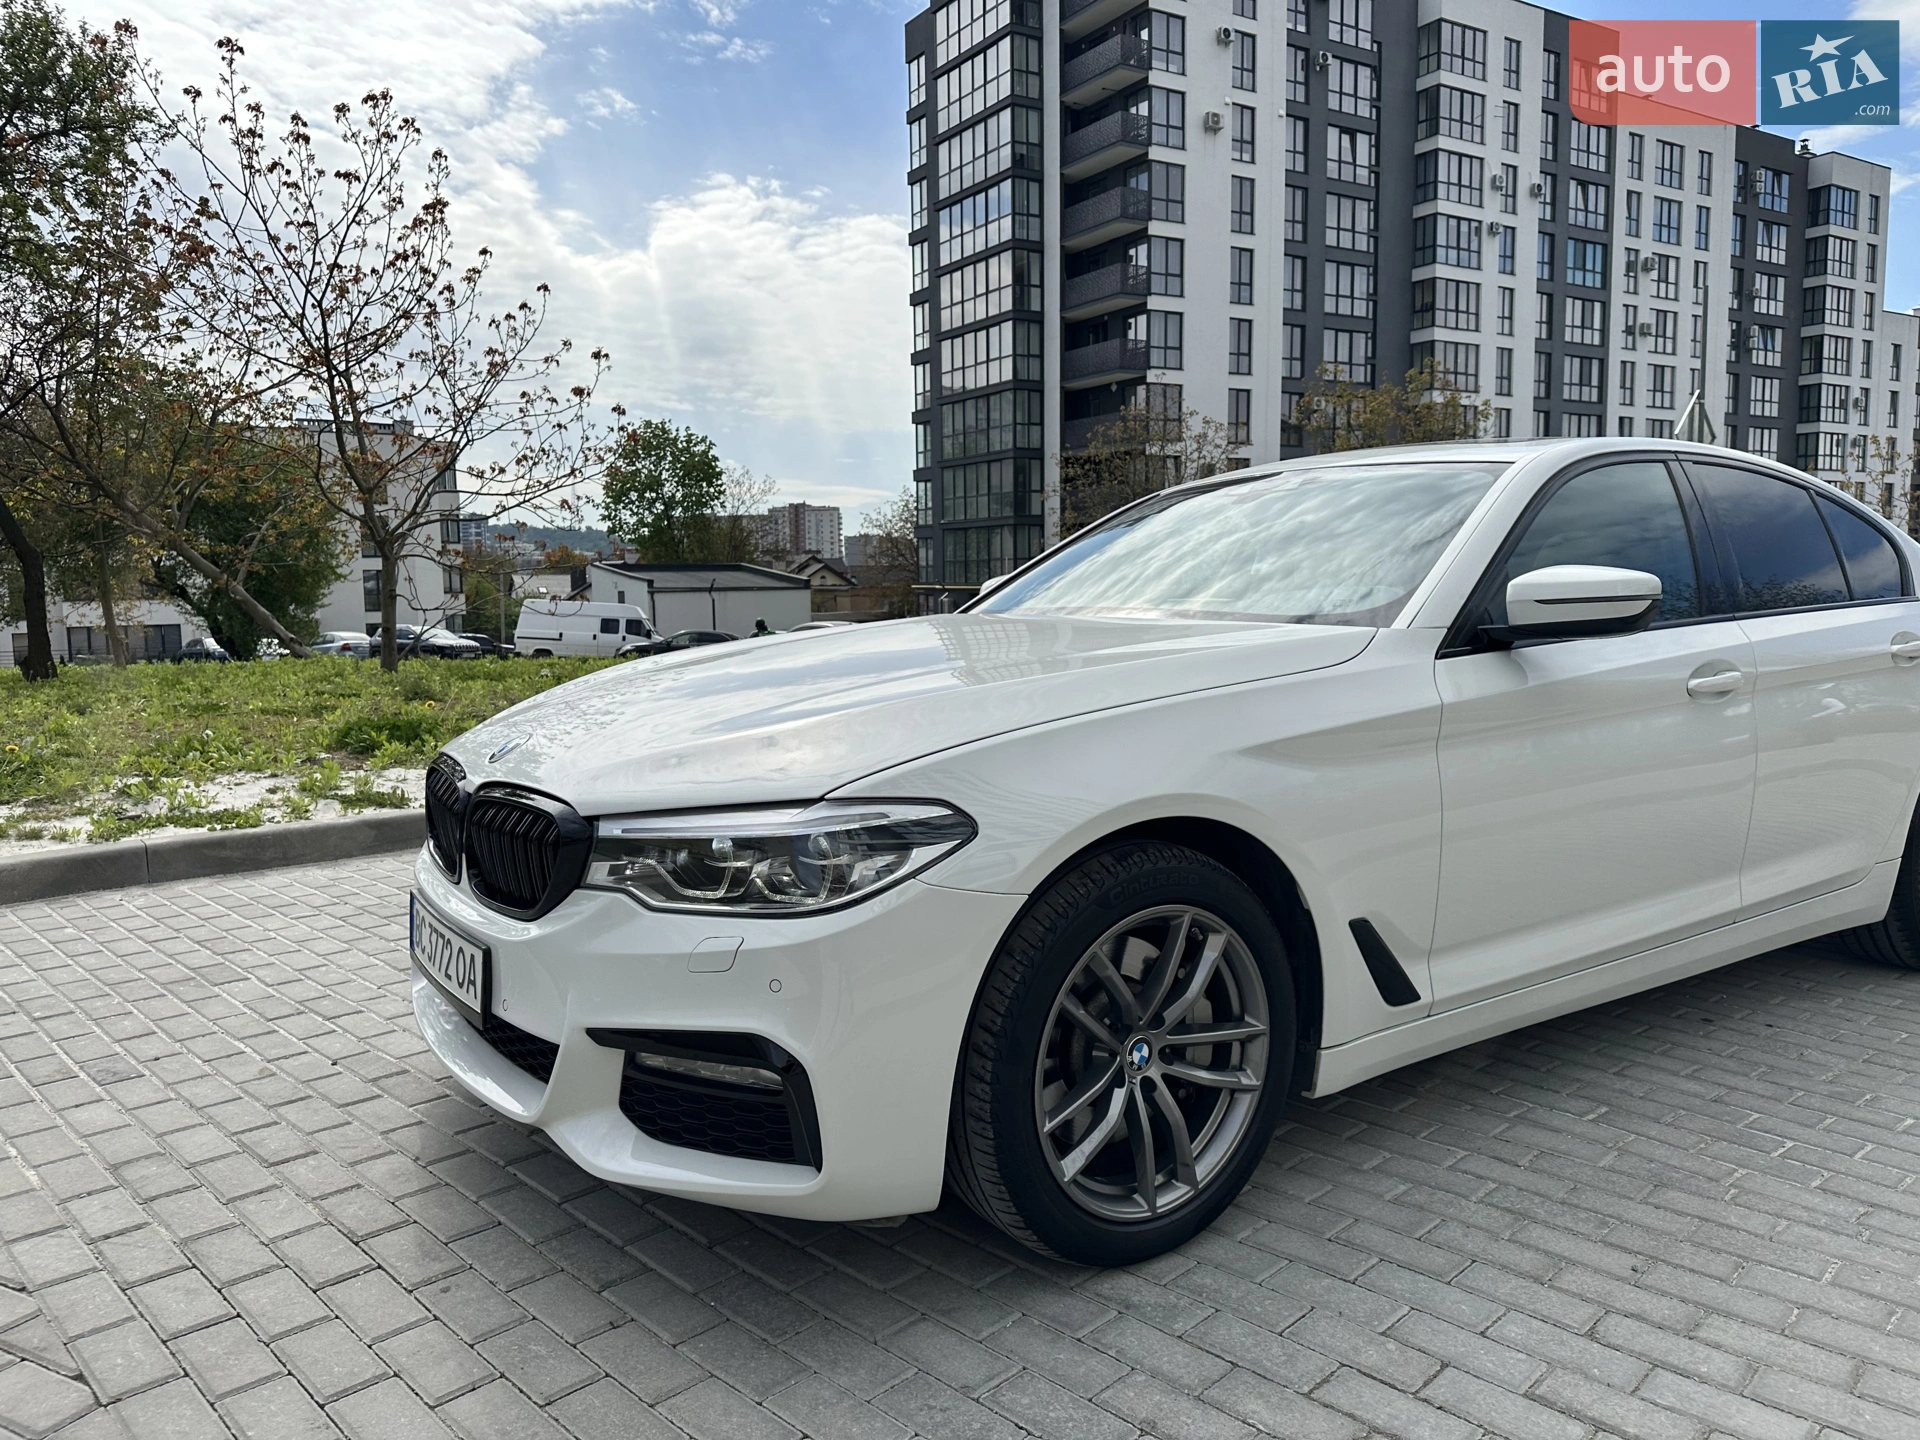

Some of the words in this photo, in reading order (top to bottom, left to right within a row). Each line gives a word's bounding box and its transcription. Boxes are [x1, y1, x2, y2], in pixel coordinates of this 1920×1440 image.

[1109, 870, 1200, 905] Cinturato
[427, 921, 453, 982] 3772
[455, 946, 477, 1001] OA
